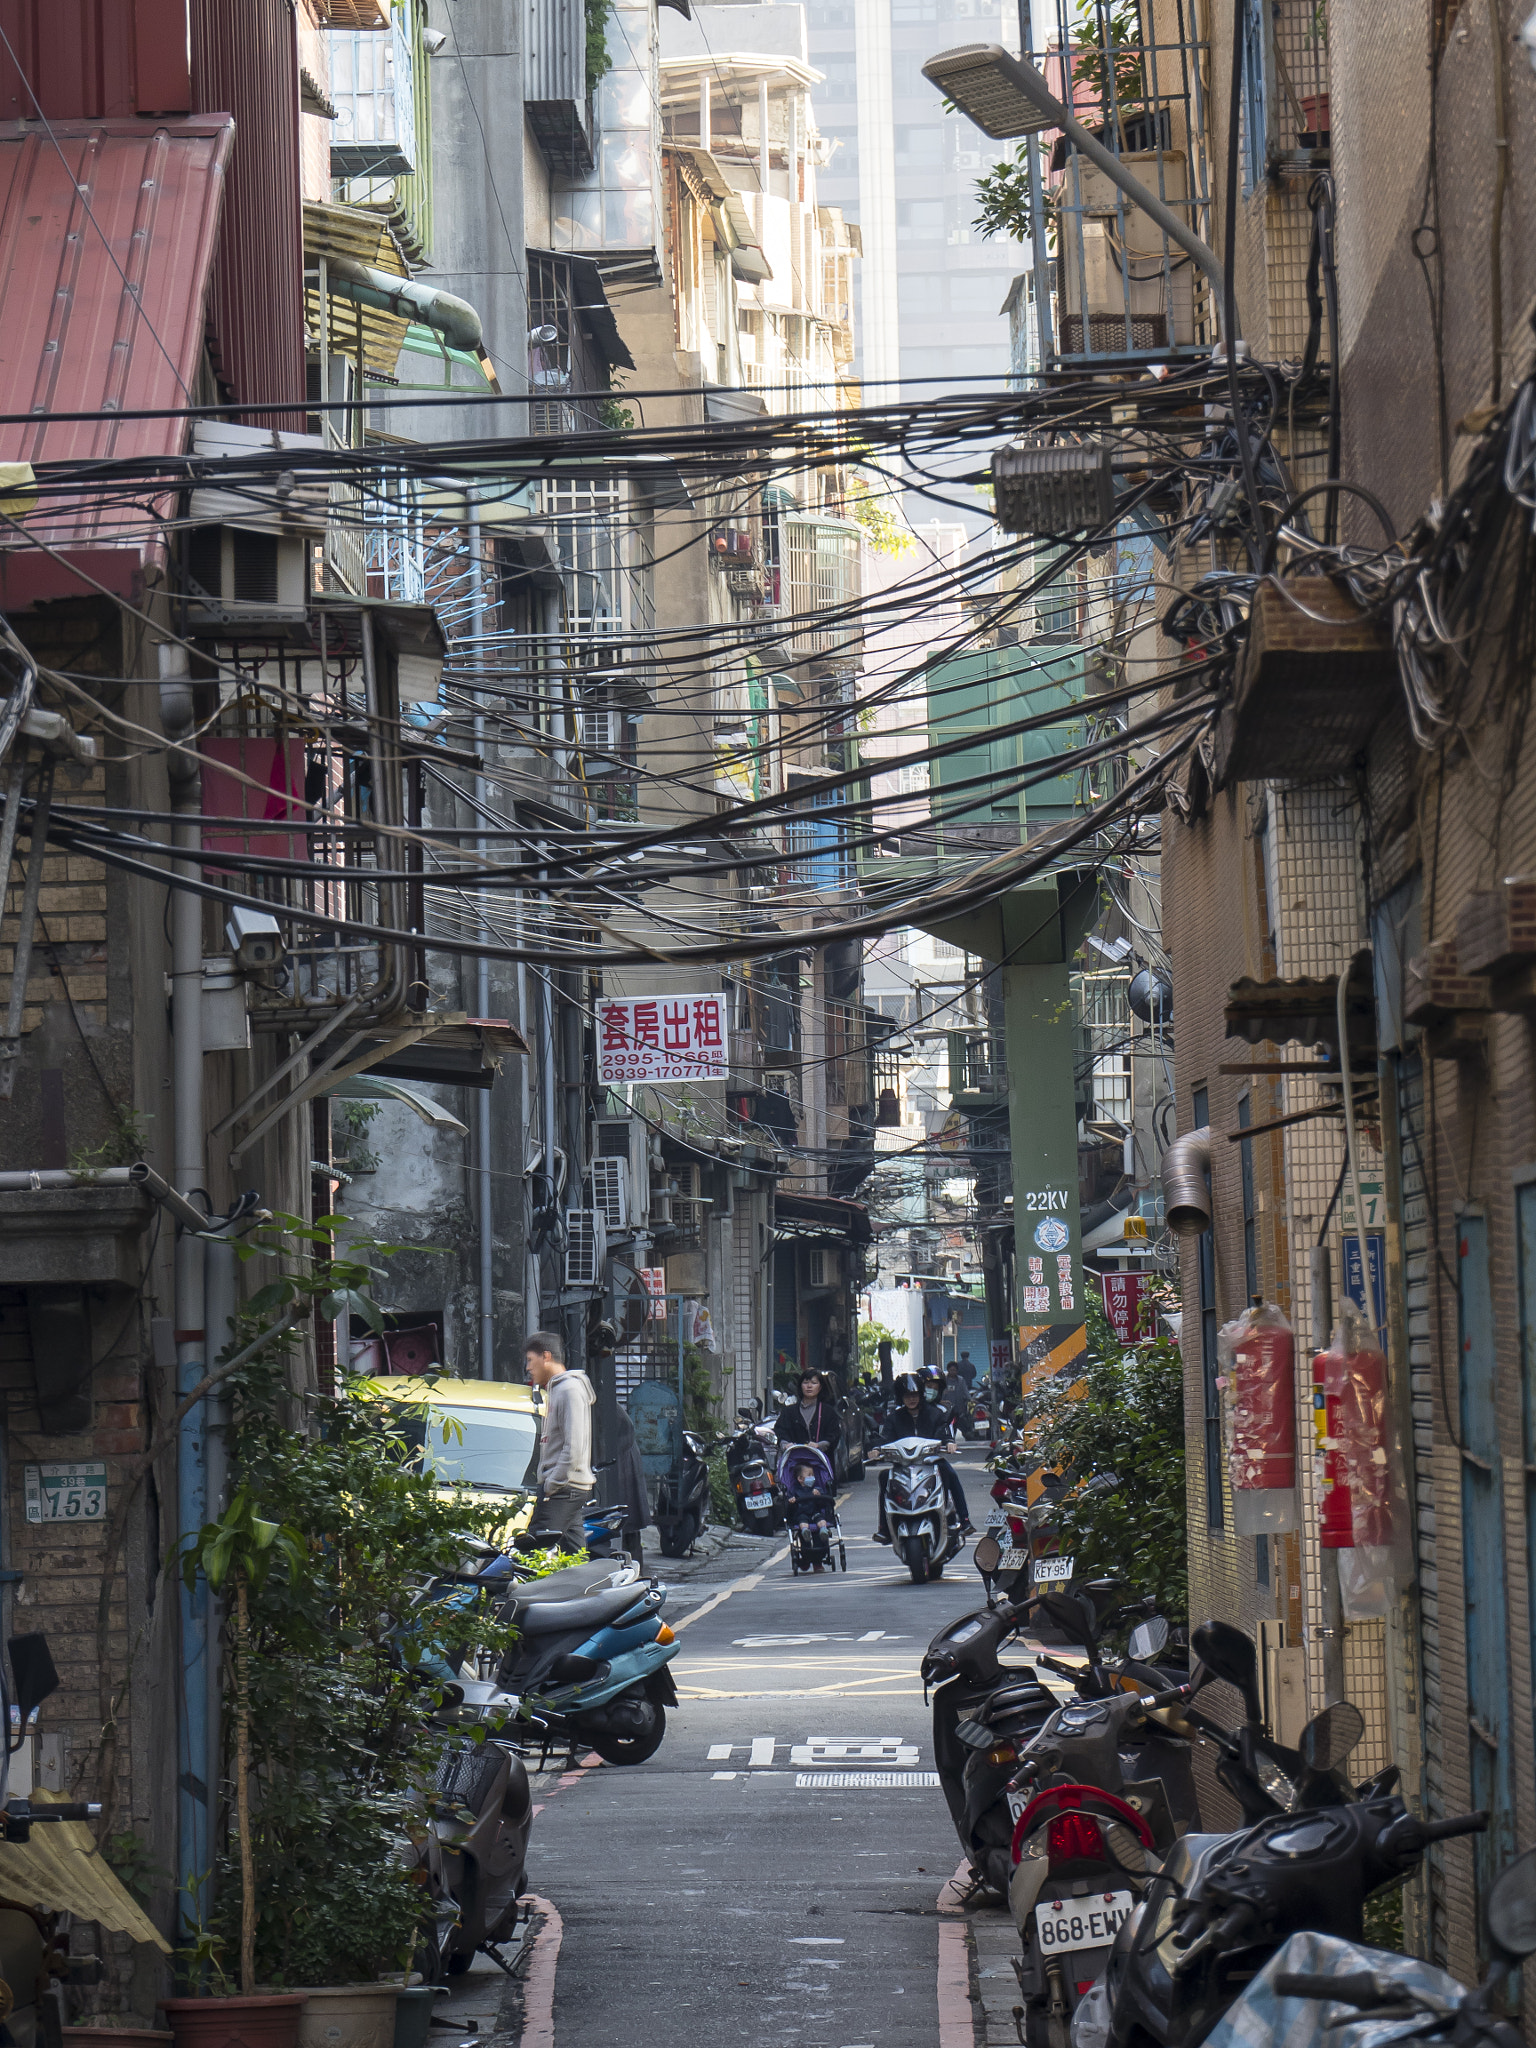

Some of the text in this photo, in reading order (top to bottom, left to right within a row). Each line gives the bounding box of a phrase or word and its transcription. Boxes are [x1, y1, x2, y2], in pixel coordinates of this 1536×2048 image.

[601, 1000, 722, 1051] 套房出租
[602, 1051, 709, 1066] 2995-1066
[602, 1065, 710, 1080] 0939-170771
[1026, 1190, 1068, 1211] 22KV
[1110, 1277, 1130, 1341] 請勿停車
[49, 1490, 102, 1518] 153
